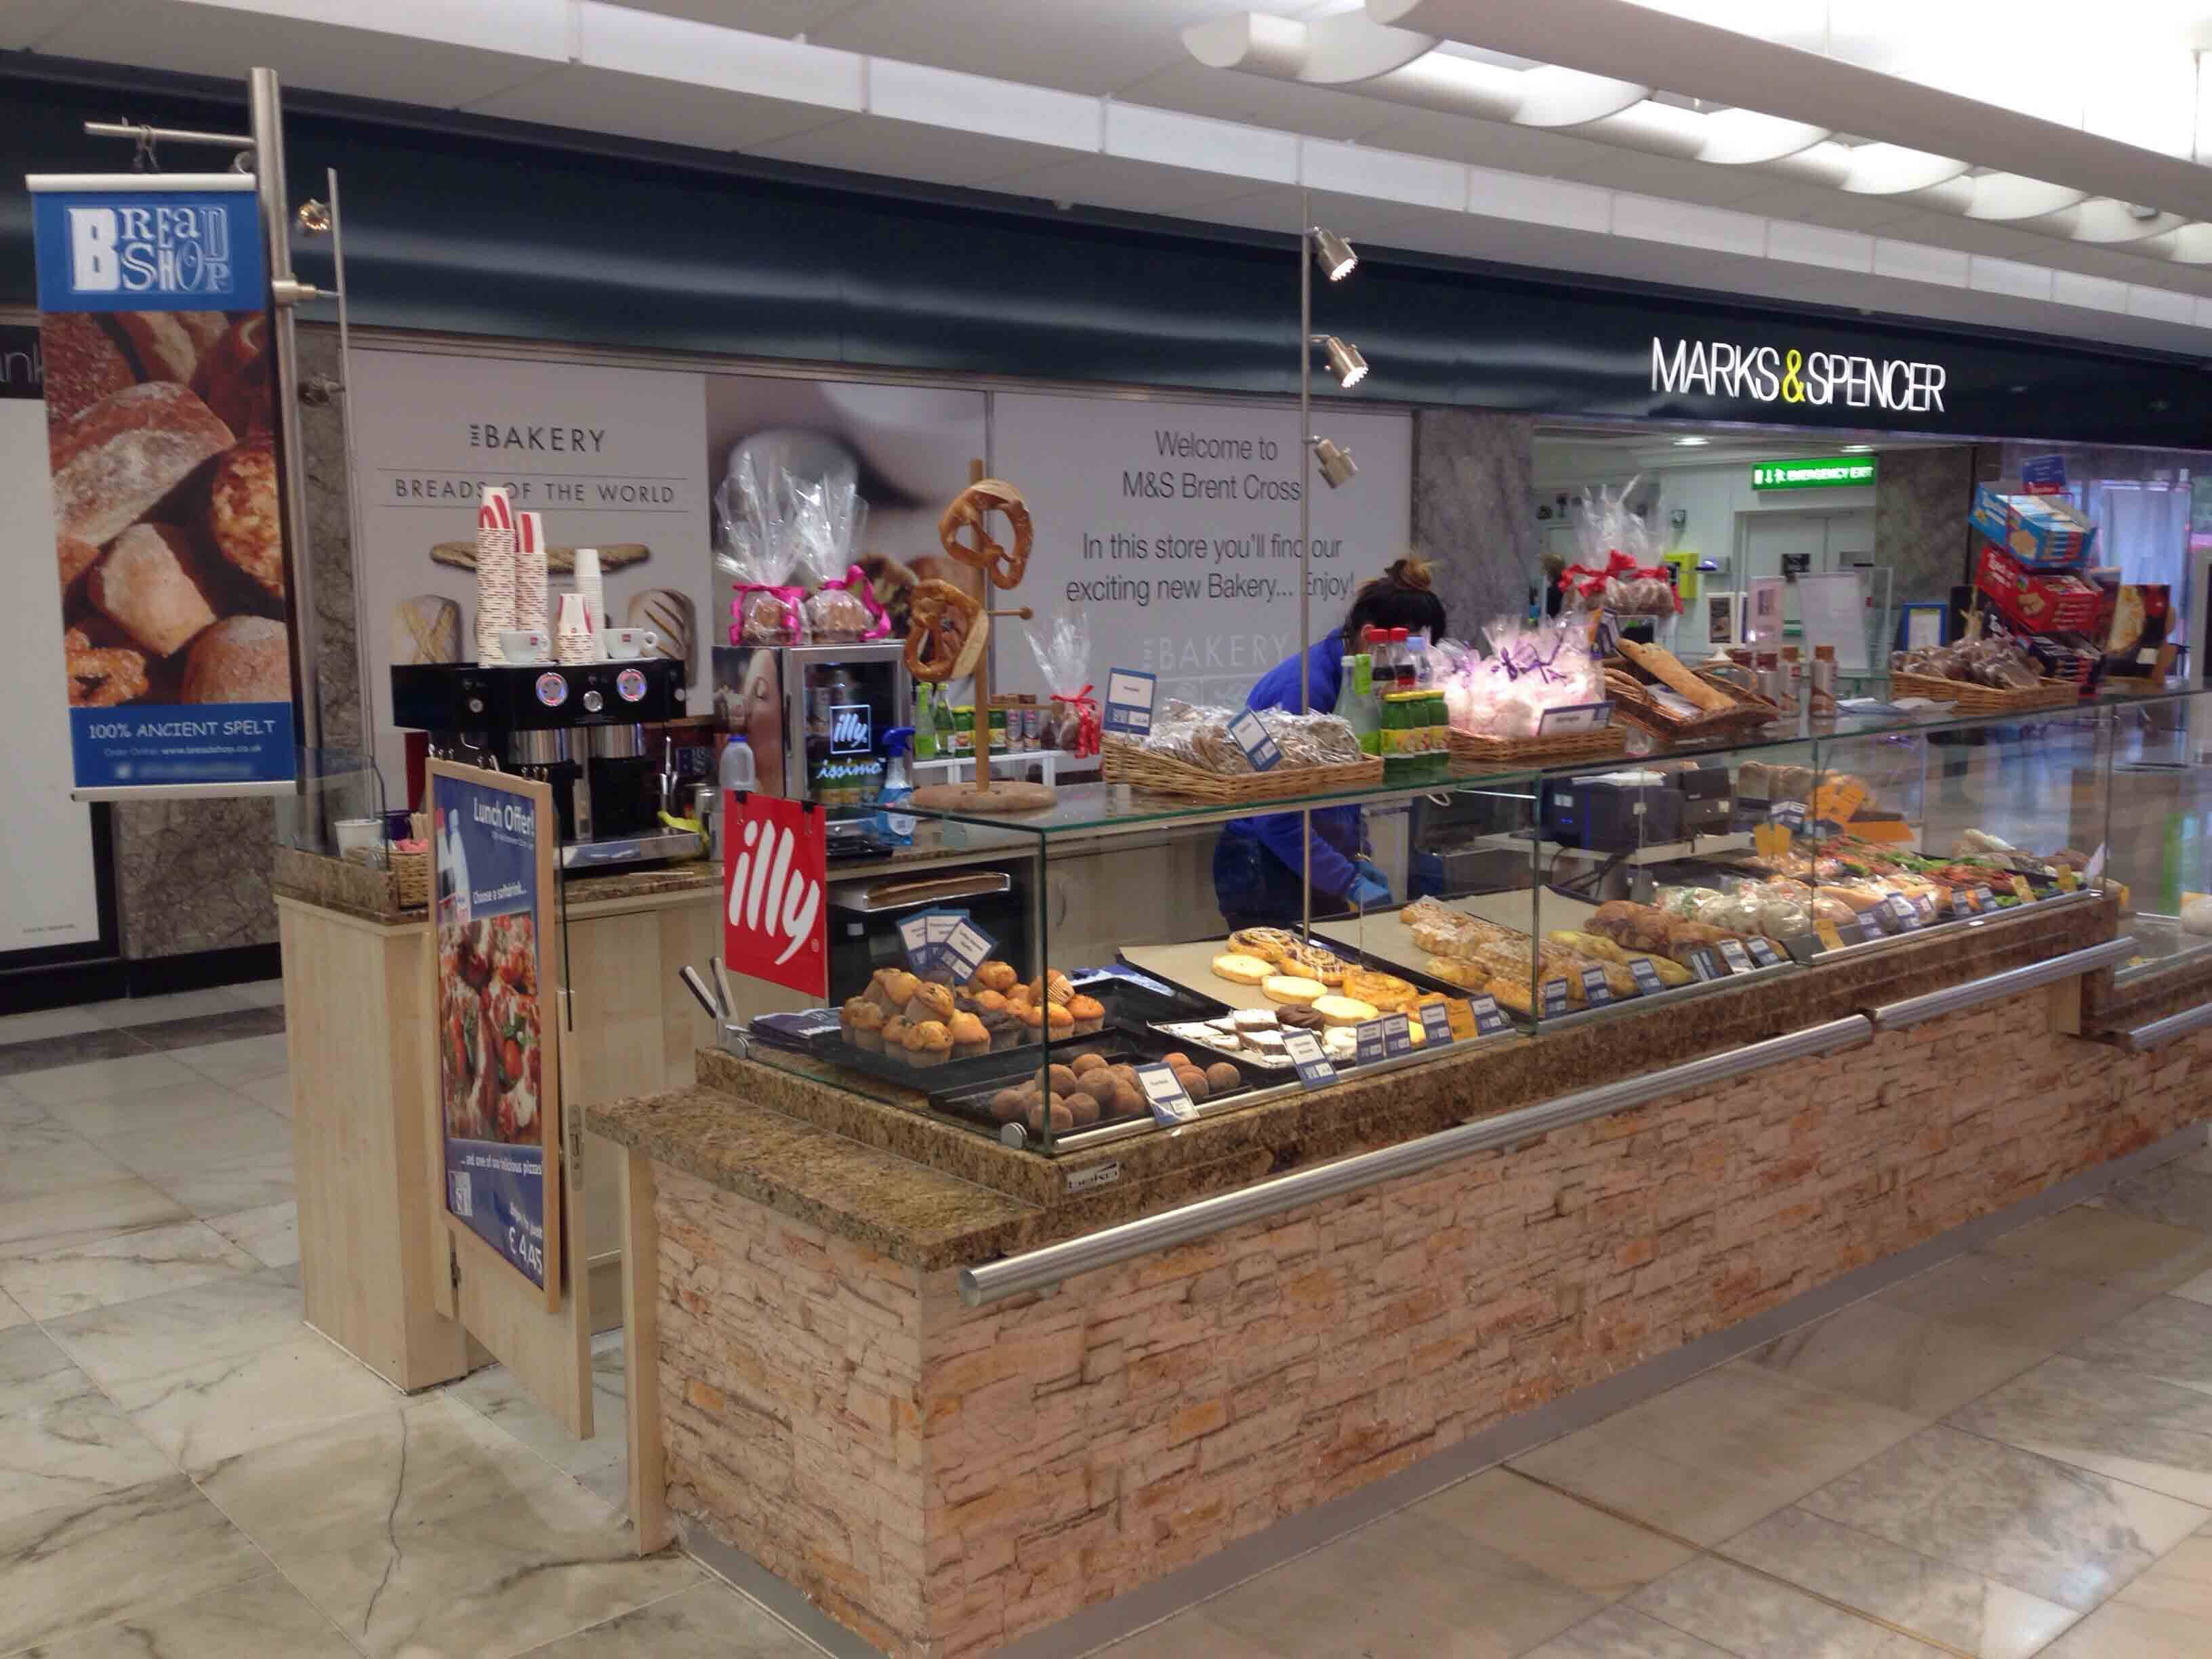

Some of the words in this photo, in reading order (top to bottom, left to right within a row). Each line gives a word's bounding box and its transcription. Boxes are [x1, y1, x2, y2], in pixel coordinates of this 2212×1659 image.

[485, 424, 606, 453] BAKERY
[1154, 429, 1253, 460] Welcome
[1258, 436, 1279, 461] to
[394, 478, 487, 500] BREADS
[503, 482, 533, 501] OF
[545, 482, 585, 501] THE
[597, 484, 675, 504] WORLD
[1122, 470, 1175, 499] M&S
[1182, 472, 1237, 499] Brent
[1244, 473, 1302, 501] Cross
[1083, 533, 1103, 559] In
[1109, 533, 1149, 560] this
[1155, 537, 1208, 560] store
[1311, 539, 1343, 559] our
[1066, 575, 1150, 607] exciting
[1157, 579, 1202, 600] new
[1160, 633, 1290, 670] BAKERY
[89, 722, 132, 739] 100%
[137, 720, 219, 737] ANCIENT
[223, 719, 276, 736] SPELT
[474, 796, 504, 828] Lunch
[729, 819, 821, 965] illy
